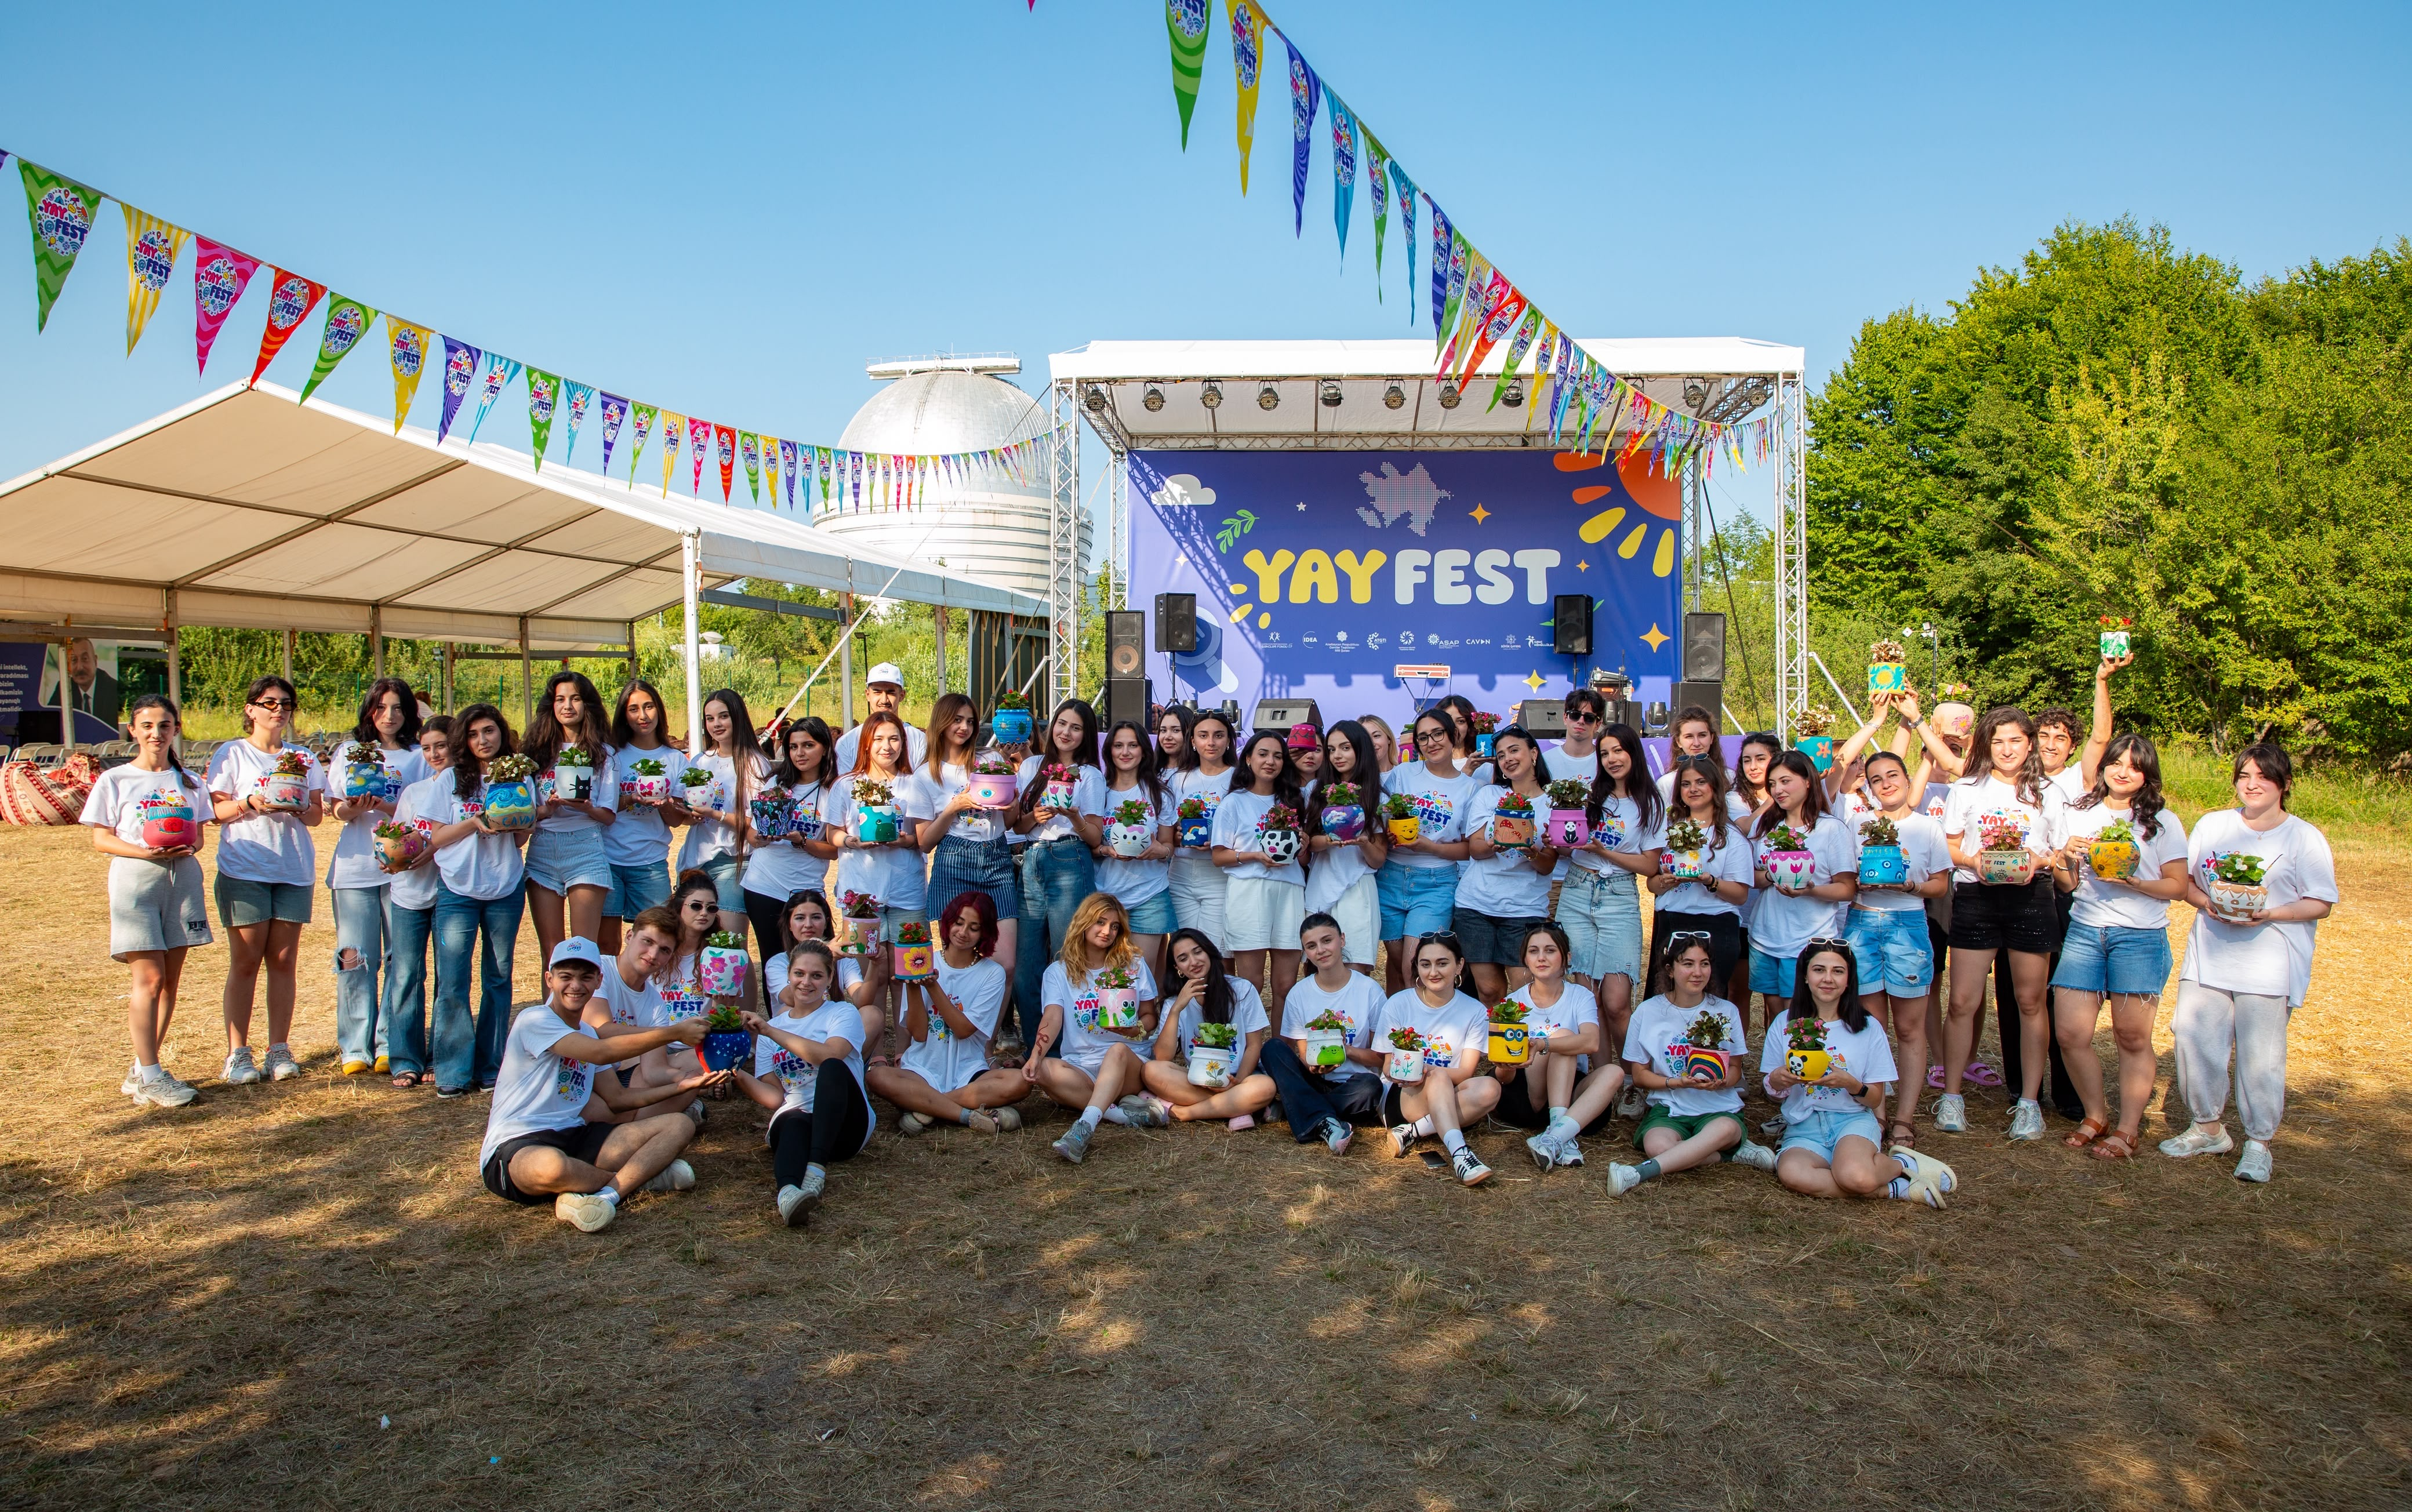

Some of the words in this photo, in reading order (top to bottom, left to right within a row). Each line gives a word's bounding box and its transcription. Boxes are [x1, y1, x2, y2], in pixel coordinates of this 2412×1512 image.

[1233, 16, 1246, 41] YAY
[1291, 75, 1301, 97] YAY
[1334, 128, 1343, 147] YAY
[42, 199, 67, 219] YAY
[44, 219, 88, 243] @FEST
[138, 240, 158, 259] YAY
[139, 259, 171, 279] @FEST
[204, 270, 223, 284] YAY
[203, 285, 233, 303] @FEST
[278, 288, 295, 304] YAY
[275, 302, 303, 318] @FEST
[1497, 309, 1508, 319] YAY
[332, 318, 347, 329] YAY
[1519, 328, 1527, 337] YAY
[396, 339, 409, 351] YAY
[452, 360, 463, 371] YAY
[487, 375, 496, 383] YAY
[533, 390, 543, 399] YAY
[1243, 548, 1387, 604] YAY
[1394, 549, 1561, 605] FEST
[619, 782, 638, 792] YA
[462, 803, 483, 813] YA
[1415, 797, 1434, 808] AY
[1410, 808, 1451, 825] @FEST
[1928, 806, 1944, 816] YA
[1102, 817, 1116, 826] YA
[1981, 815, 2008, 826] YAY
[1661, 853, 1675, 864] YA
[660, 991, 683, 1001] YAY
[1075, 999, 1099, 1011] YAY
